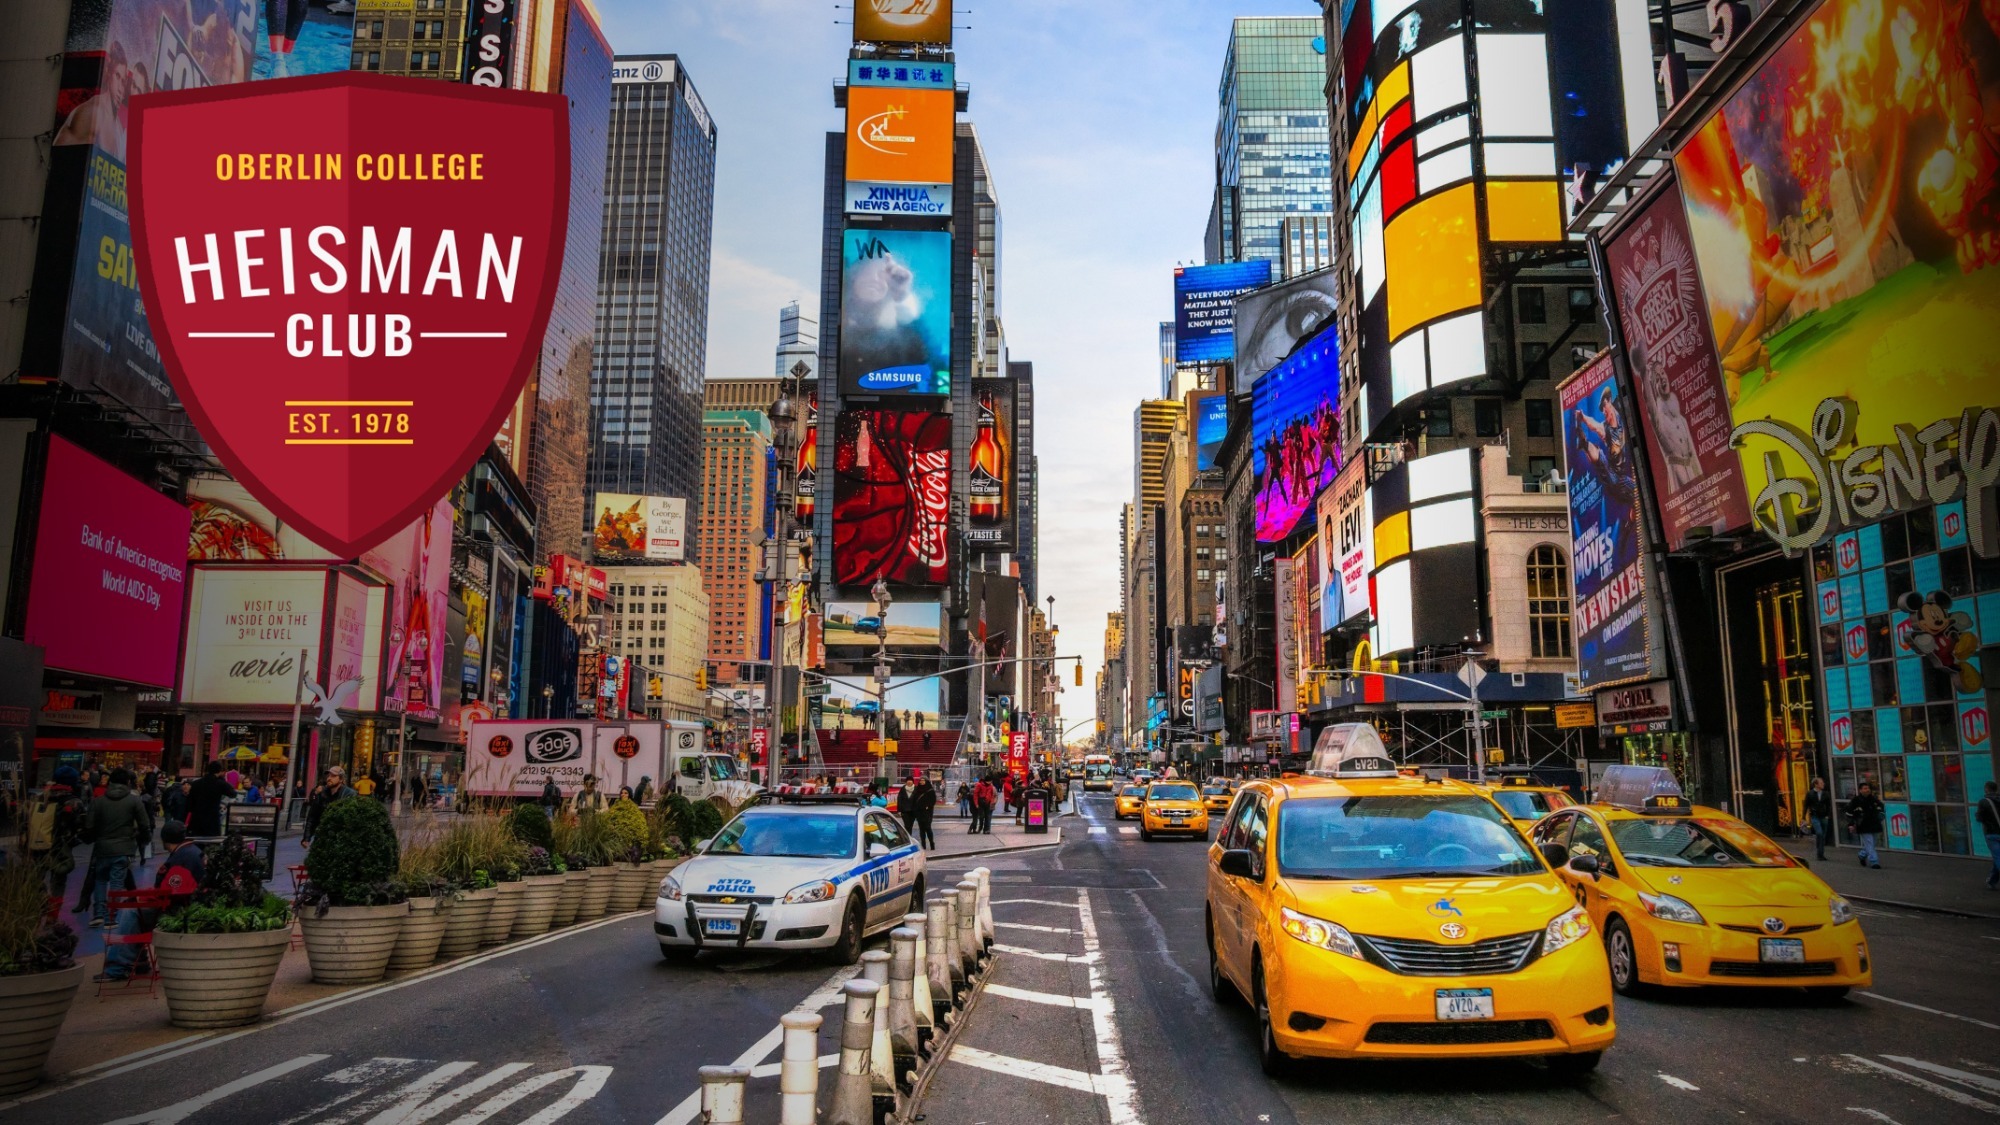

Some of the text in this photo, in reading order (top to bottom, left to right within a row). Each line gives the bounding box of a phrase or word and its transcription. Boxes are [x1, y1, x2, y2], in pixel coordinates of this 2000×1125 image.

[612, 68, 638, 78] anz
[858, 66, 943, 82] 新华通讯社
[868, 187, 930, 201] XINHUA
[854, 201, 944, 212] NEWS AGENCY
[1184, 301, 1218, 309] MATILDA
[1642, 279, 1675, 324] GREAT
[1188, 309, 1229, 319] THEY JUST
[1188, 319, 1213, 328] KNOW
[1645, 299, 1681, 346] COMET
[868, 373, 922, 383] SAMSUNG
[662, 501, 672, 510] By
[1513, 517, 1568, 529] THE SHO
[654, 526, 668, 534] did
[994, 531, 1002, 540] IS
[1340, 505, 1362, 556] LEVI
[1573, 521, 1599, 556] NOTHING
[81, 524, 182, 583] Bank of America recognizes
[1574, 526, 1614, 585] MOVES
[1600, 557, 1614, 580] LIKE
[102, 568, 161, 611] World AIDS Day.
[244, 601, 292, 612] VISIT US
[225, 614, 308, 626] INSIDE ON THE
[1282, 568, 1295, 680] PALACE
[238, 628, 292, 640] 3RD LEVEL
[1602, 624, 1613, 644] ON
[229, 651, 293, 678] aerie
[1613, 688, 1653, 710] DIGITAL
[1649, 721, 1667, 731] SONY
[536, 736, 572, 755] edge
[753, 732, 765, 755] tkts
[1013, 733, 1026, 758] tkts
[540, 766, 584, 776] 947-3343
[1656, 796, 1679, 808] 7L66
[717, 878, 752, 886] NYPD
[869, 866, 890, 897] NYPD
[706, 884, 756, 894] POLICE
[708, 919, 731, 931] 4135
